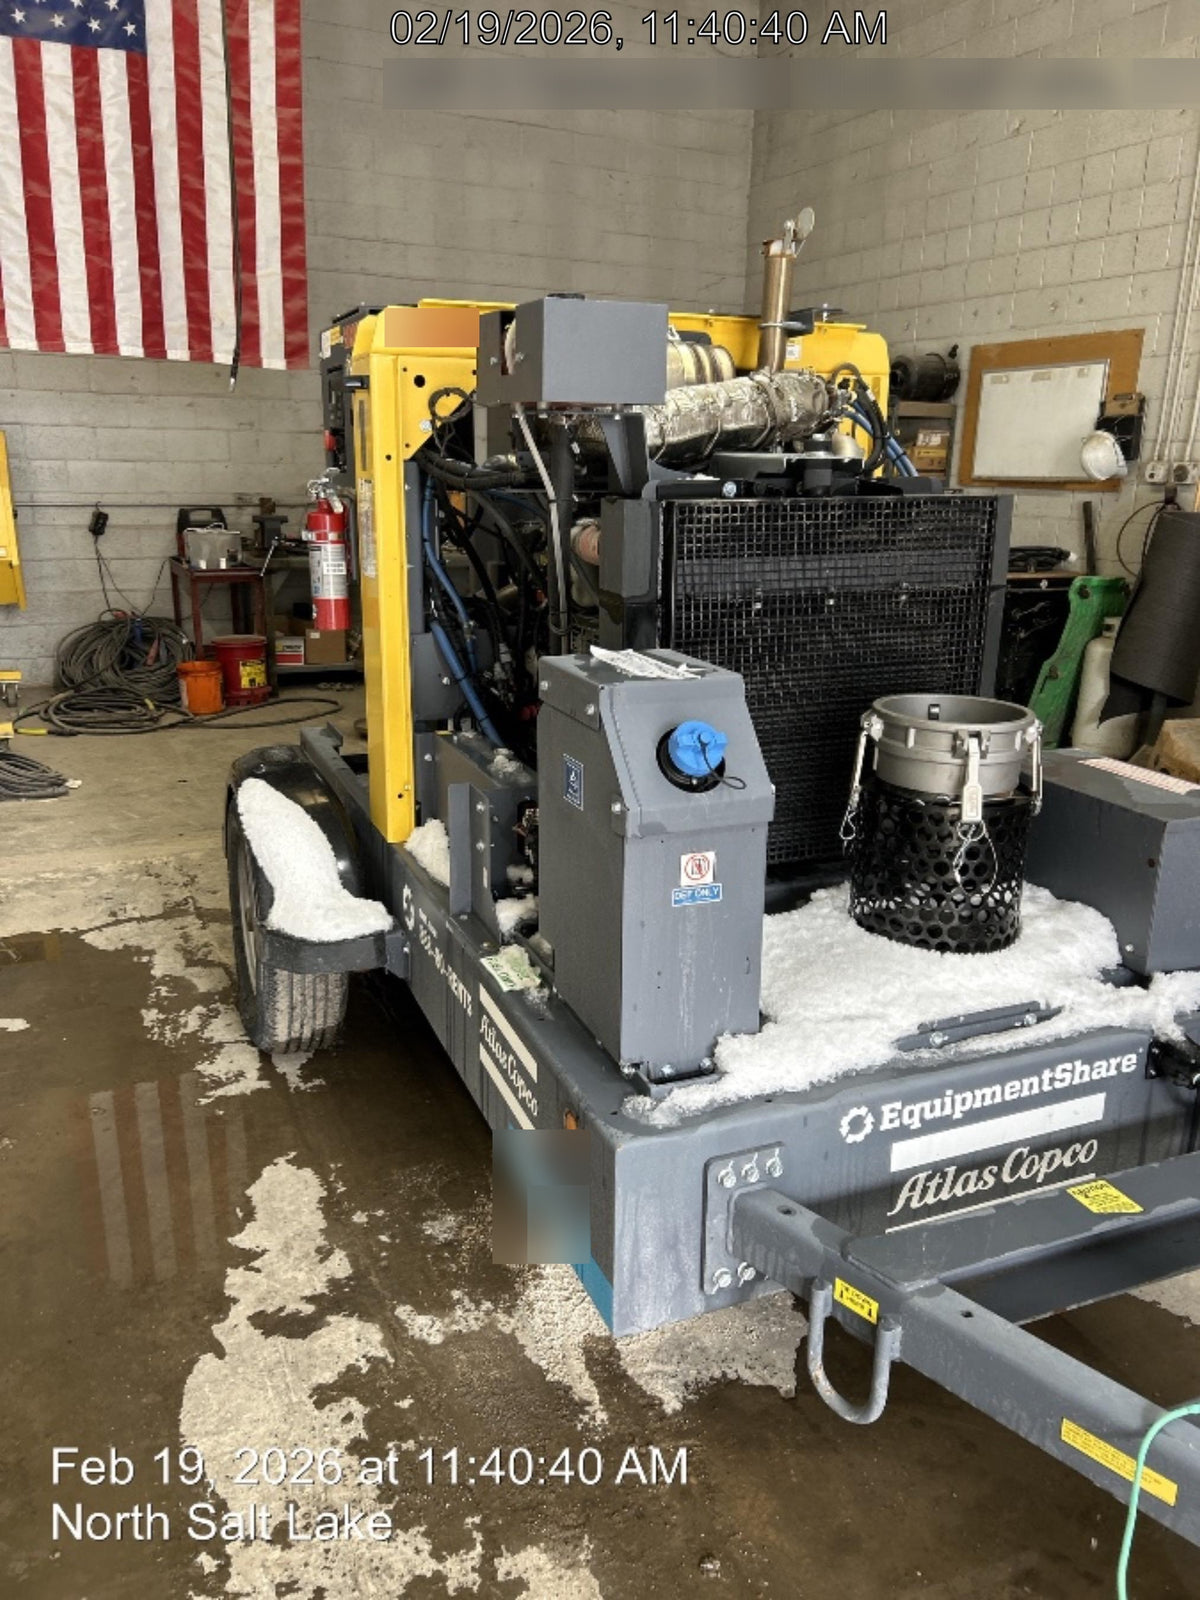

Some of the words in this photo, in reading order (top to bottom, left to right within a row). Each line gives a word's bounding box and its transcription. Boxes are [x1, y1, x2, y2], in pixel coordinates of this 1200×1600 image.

[479, 1014, 508, 1070] Atlas
[507, 1053, 538, 1117] Copco
[879, 1052, 1138, 1132] EquipmentShare
[886, 1163, 999, 1217] Atlas
[1001, 1138, 1099, 1184] Copco
